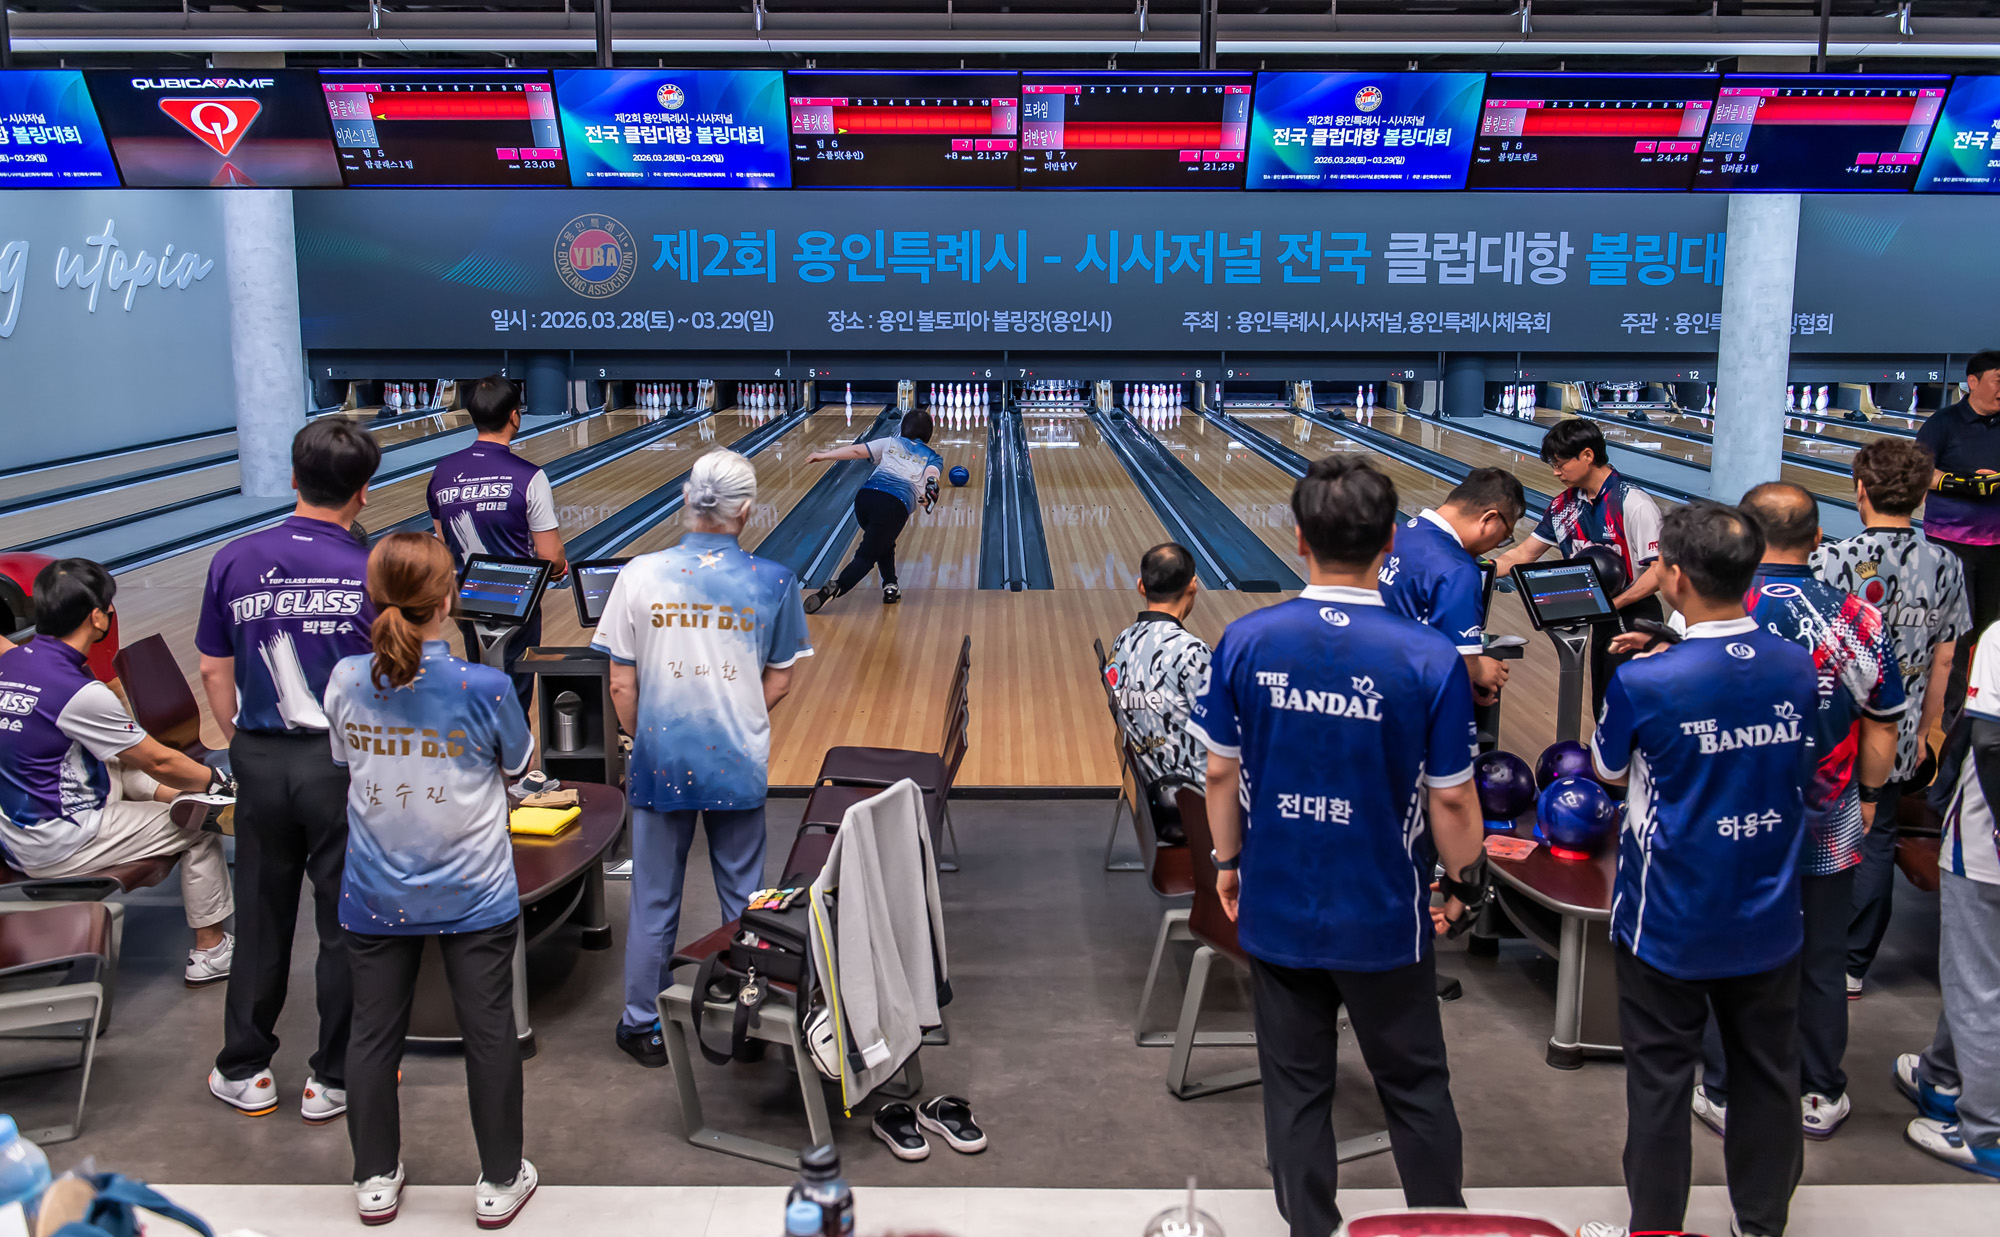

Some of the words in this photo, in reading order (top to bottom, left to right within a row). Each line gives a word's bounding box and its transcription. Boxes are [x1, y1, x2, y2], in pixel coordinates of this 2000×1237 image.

[132, 78, 216, 90] QUBICA
[226, 78, 274, 88] AMF
[368, 94, 374, 103] 9
[543, 98, 548, 115] 0
[1024, 101, 1048, 119] 프라임
[1074, 95, 1079, 105] X
[1759, 98, 1765, 107] 9
[9, 113, 46, 124] 시사저널
[615, 113, 641, 124] 제2회
[642, 113, 688, 124] 용인특례시
[696, 113, 733, 124] 시사저널
[1006, 112, 1012, 130] 8
[1307, 116, 1332, 126] 제2회
[1334, 116, 1381, 126] 용인특례시
[1388, 116, 1425, 126] 시사저널
[1694, 115, 1702, 133] 0
[12, 126, 83, 145] 볼링대회
[585, 125, 620, 144] 전국
[623, 125, 691, 144] 클럽대항
[696, 126, 764, 145] 볼링대회
[1024, 129, 1057, 146] 더반달V
[1235, 128, 1241, 145] 0
[1273, 128, 1307, 146] 전국
[1311, 128, 1380, 146] 클럽대항
[1384, 128, 1452, 146] 볼링대회
[1915, 131, 1922, 147] 0
[1953, 131, 1988, 149] 전국
[633, 154, 685, 163] 2026.03.28(토)
[692, 154, 724, 163] 03.29(일)
[977, 152, 1008, 161] 21,37
[1314, 156, 1366, 165] 2026.03.28(토)
[1372, 156, 1405, 165] 03.29(일)
[1657, 154, 1688, 163] 24,44
[524, 161, 556, 169] 23,08
[1203, 163, 1234, 172] 21,29
[1877, 165, 1907, 174] 23,51
[574, 248, 618, 266] YIBA
[652, 228, 776, 283] 제2회
[792, 229, 1027, 284] 용인특례시
[1074, 230, 1261, 284] 시사저널
[1276, 230, 1372, 284] 전국
[1384, 231, 1574, 285] 클럽대항
[1585, 232, 1727, 286] 볼링대
[56, 219, 214, 312] utopia
[558, 251, 587, 292] BOWLING
[587, 252, 633, 295] ASSOCIATION
[491, 310, 527, 332] 일시
[540, 310, 675, 332] 2026.03.28(토)
[691, 310, 774, 332] 03.29(일)
[827, 310, 865, 332] 장소
[877, 310, 914, 332] 용인
[916, 310, 989, 332] 볼토피아
[991, 310, 1112, 332] 볼링장(용인시)
[1183, 312, 1218, 332] 주최
[1235, 312, 1551, 334] 용인특례시,시사저널,용인특례시체육회
[1620, 312, 1658, 334] 주관
[1673, 312, 1722, 334] 용인특
[327, 368, 332, 376] 1
[599, 369, 605, 377] 3
[774, 369, 780, 377] 4
[809, 369, 815, 378] 5
[985, 369, 992, 378] 6
[1020, 369, 1026, 378] 7
[1195, 370, 1202, 378] 8
[1228, 370, 1234, 378] 9
[1404, 370, 1414, 379] 10
[1514, 370, 1522, 378] 1
[1689, 371, 1699, 379] 12
[1896, 372, 1906, 380] 14
[1928, 372, 1938, 380] 15
[435, 487, 460, 507] TOP
[460, 483, 513, 501] CLASS
[1378, 566, 1396, 586] AL
[228, 591, 274, 625] TOP
[274, 590, 363, 616] CLASS
[651, 603, 713, 628] SPLIT
[718, 605, 755, 632] B.C
[302, 621, 353, 634] 박명수
[1256, 672, 1289, 687] THE
[0, 690, 38, 716] ASS
[1269, 687, 1383, 722] BANDAL
[1680, 719, 1718, 735] THE
[345, 722, 415, 756] SPLIT
[422, 728, 466, 758] B.C
[1698, 720, 1802, 754] BANDAL
[1277, 794, 1353, 825] 전대환
